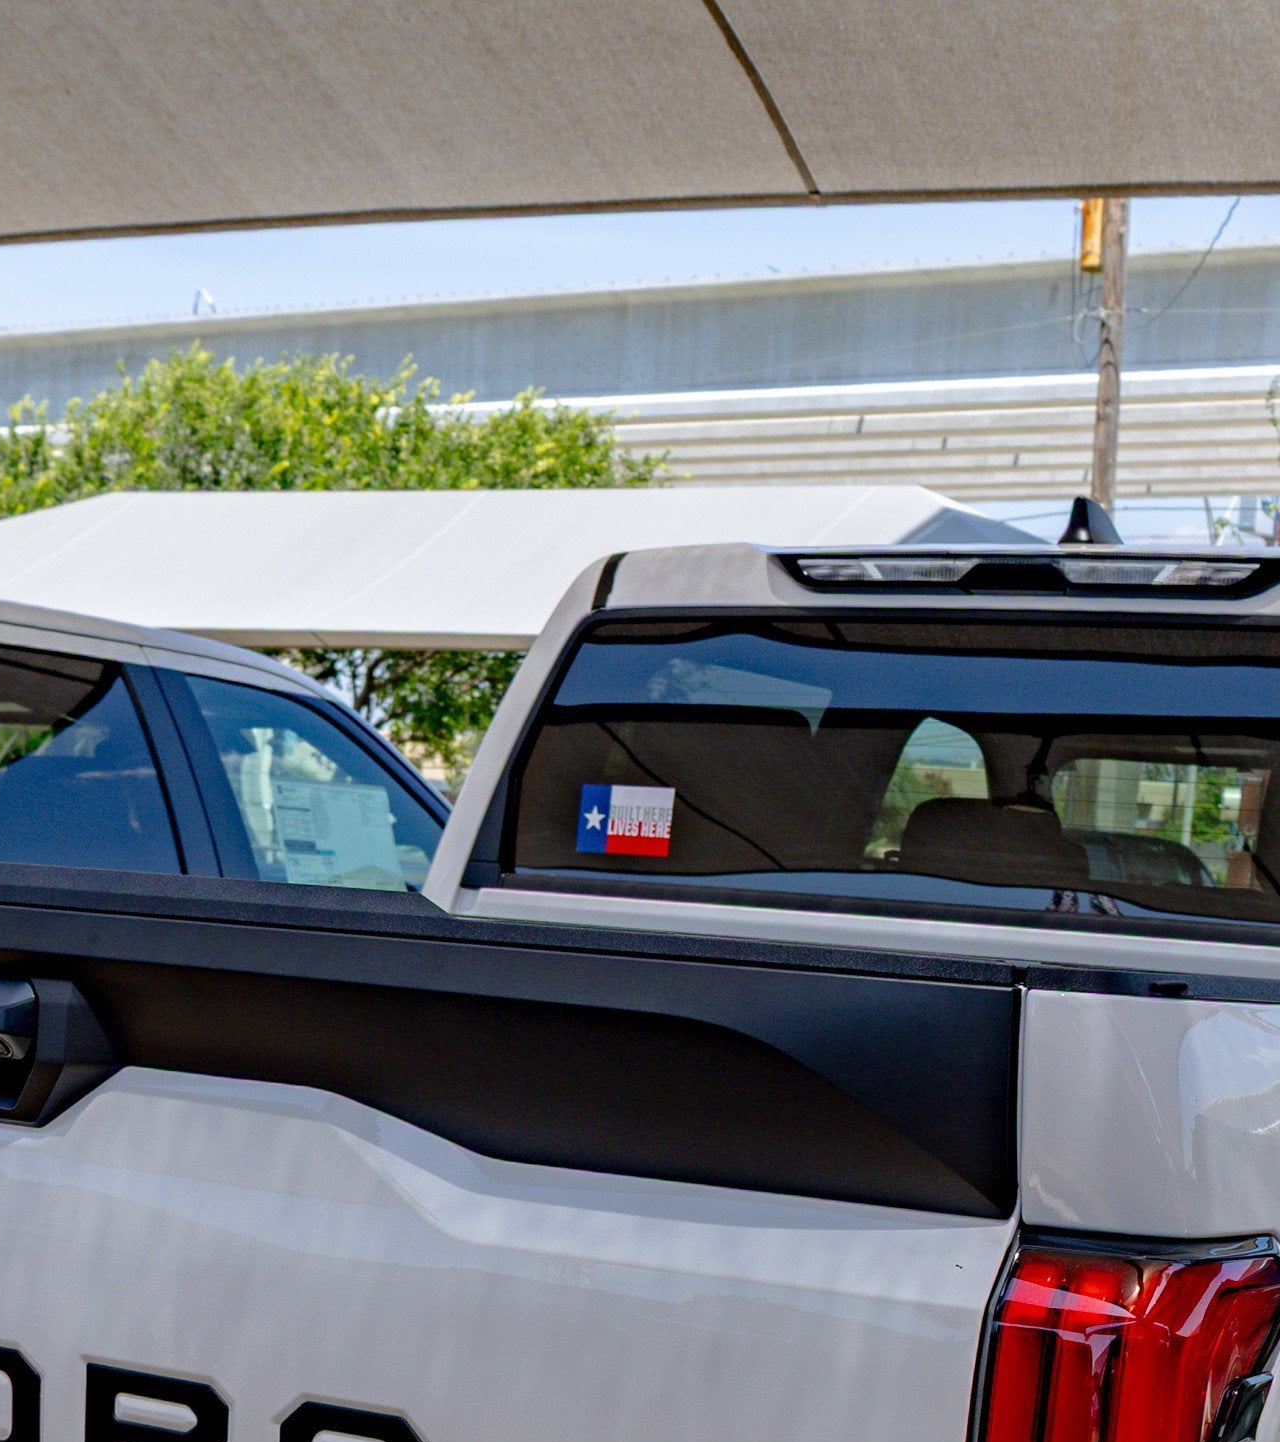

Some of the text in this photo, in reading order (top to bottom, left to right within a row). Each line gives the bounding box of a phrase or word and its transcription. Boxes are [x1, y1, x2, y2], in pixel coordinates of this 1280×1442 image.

[609, 805, 673, 823] BUILT HERE
[607, 818, 671, 839] LIVES HERE
